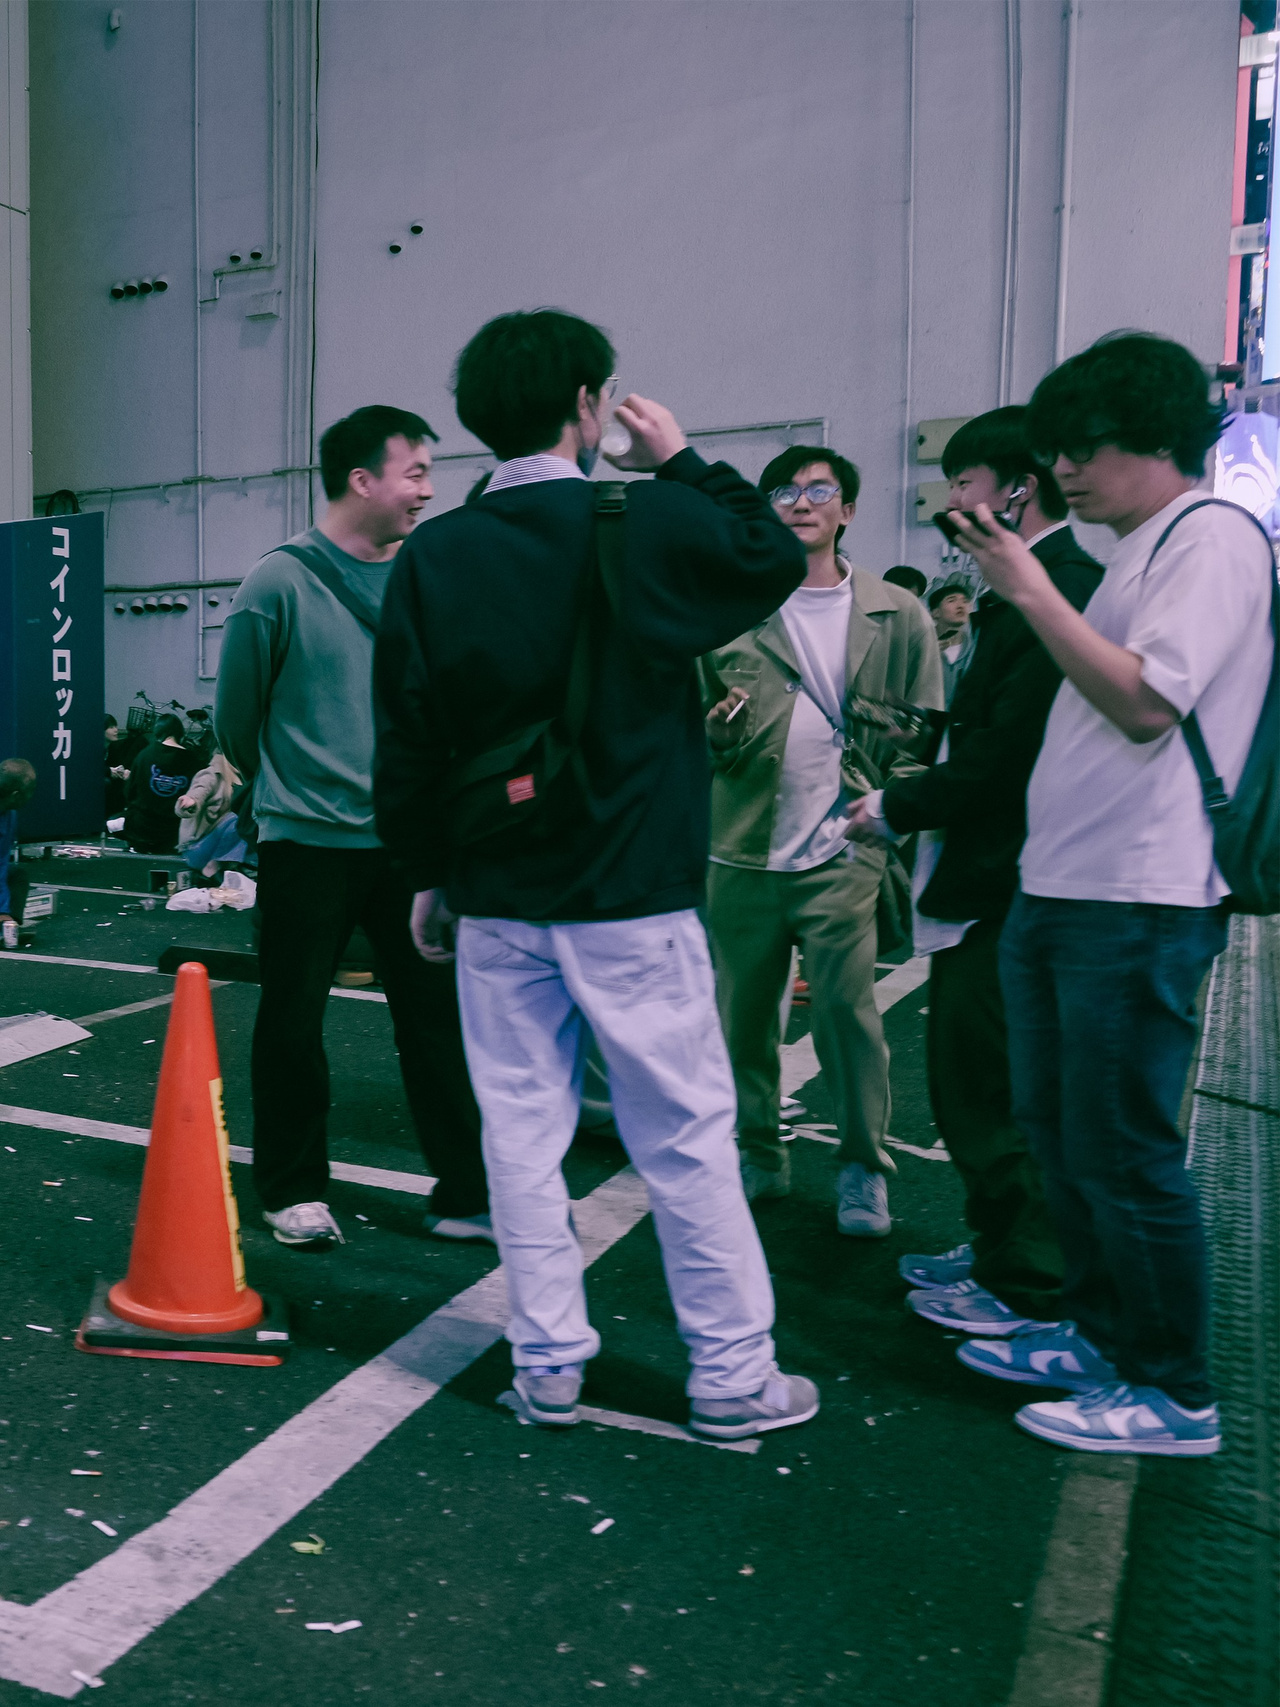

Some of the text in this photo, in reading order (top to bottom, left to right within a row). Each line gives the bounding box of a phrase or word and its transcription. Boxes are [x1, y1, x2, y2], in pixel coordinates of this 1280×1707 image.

[49, 527, 73, 800] コインロッカー
